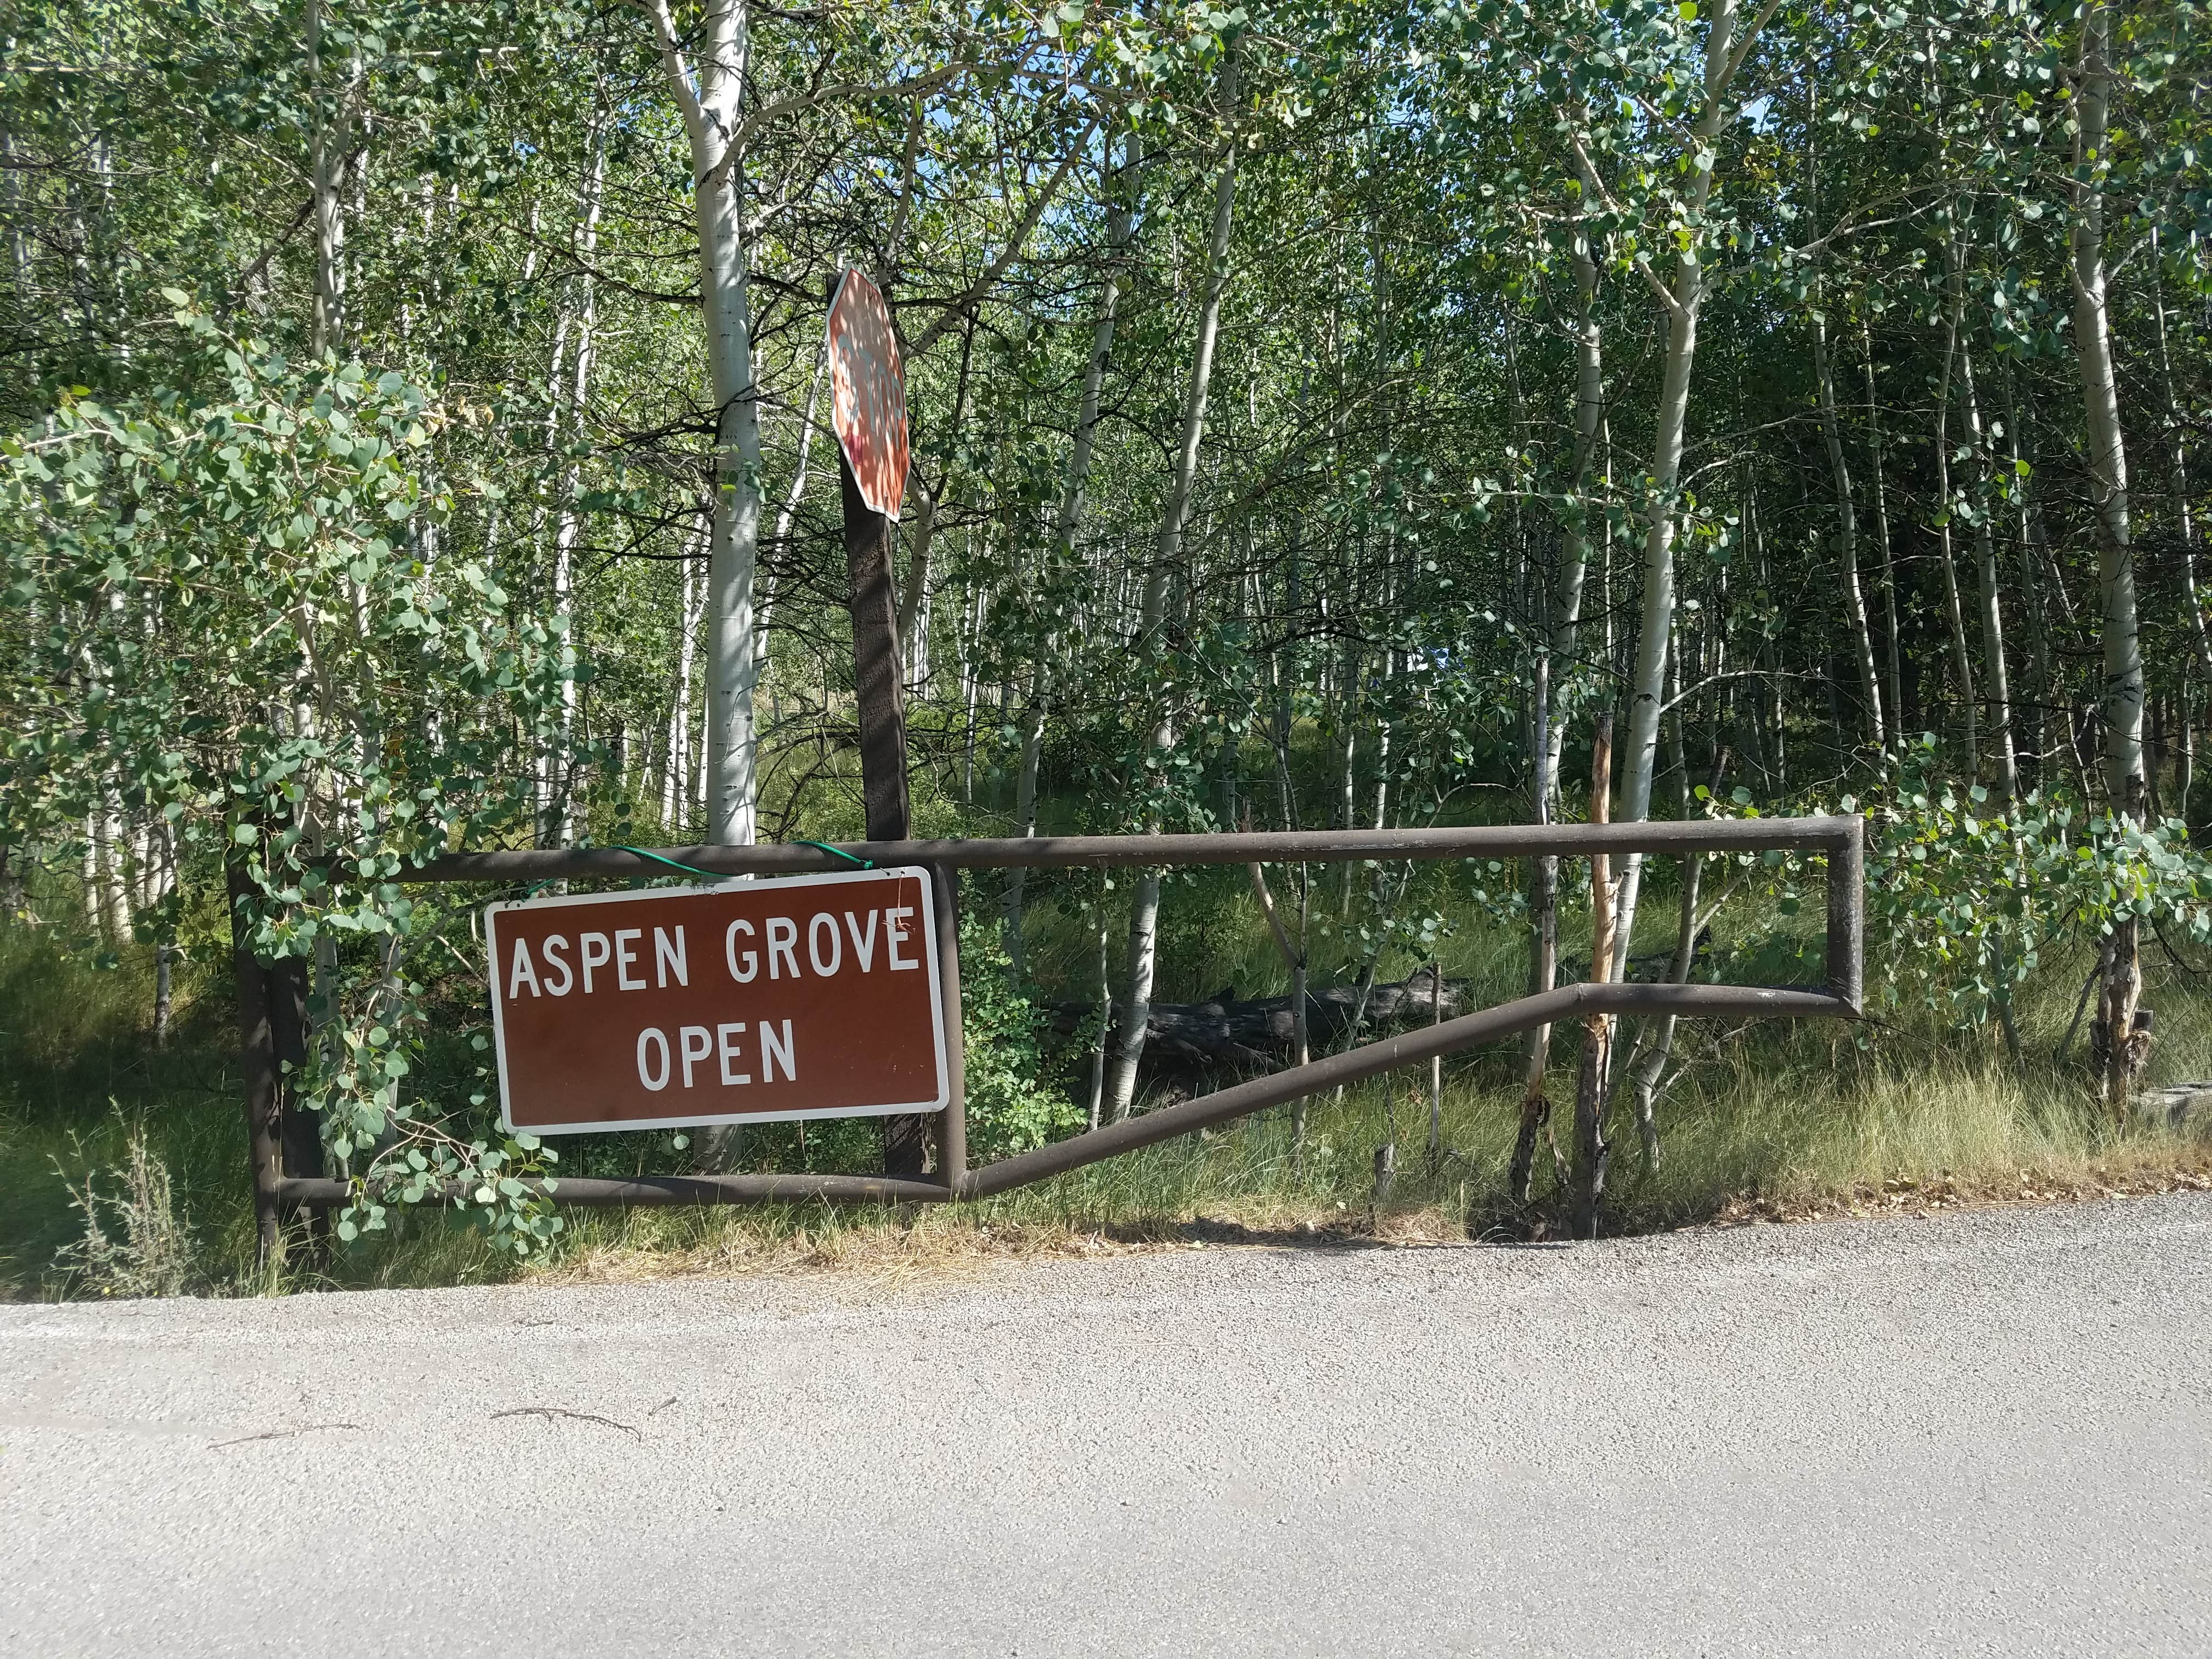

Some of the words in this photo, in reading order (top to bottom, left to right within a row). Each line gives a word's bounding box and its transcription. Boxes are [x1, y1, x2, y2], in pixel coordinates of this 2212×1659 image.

[837, 334, 903, 450] STOP
[509, 925, 689, 999] ASPEN
[726, 906, 919, 983] GROVE
[637, 1019, 796, 1091] OPEN
